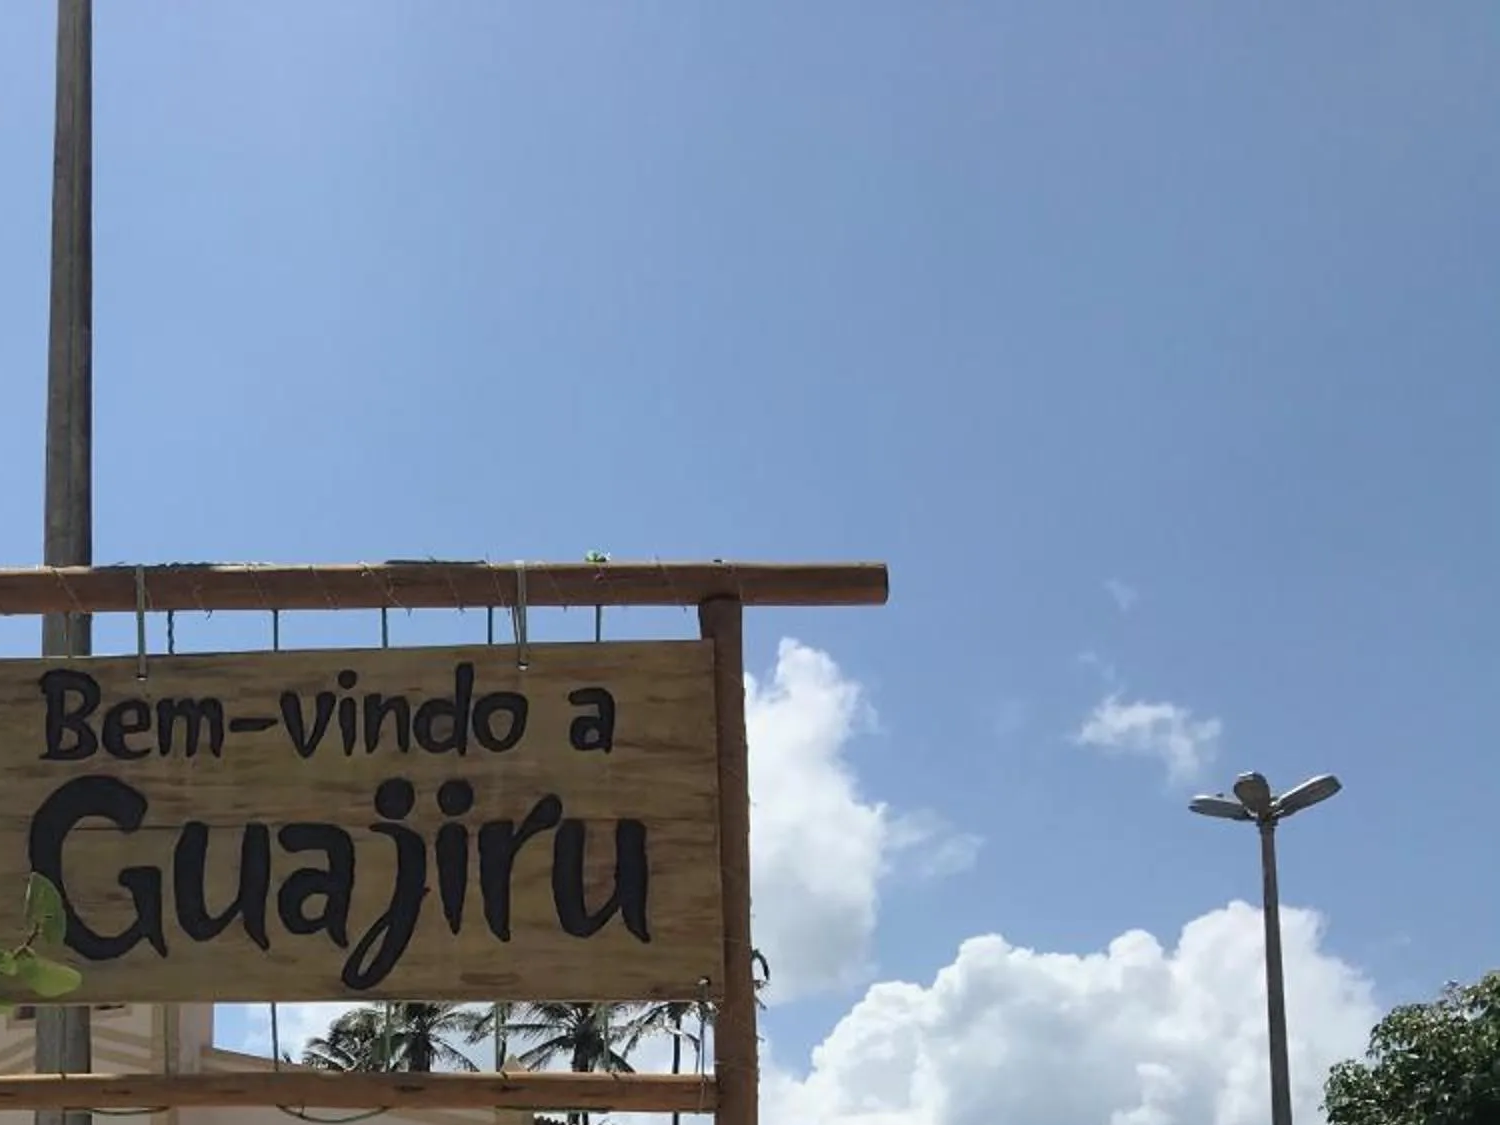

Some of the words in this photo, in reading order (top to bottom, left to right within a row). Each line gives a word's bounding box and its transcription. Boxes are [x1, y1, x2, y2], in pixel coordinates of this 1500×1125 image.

[38, 662, 530, 762] Bem-vindo
[567, 686, 616, 755] a
[28, 774, 652, 991] Guajiru
